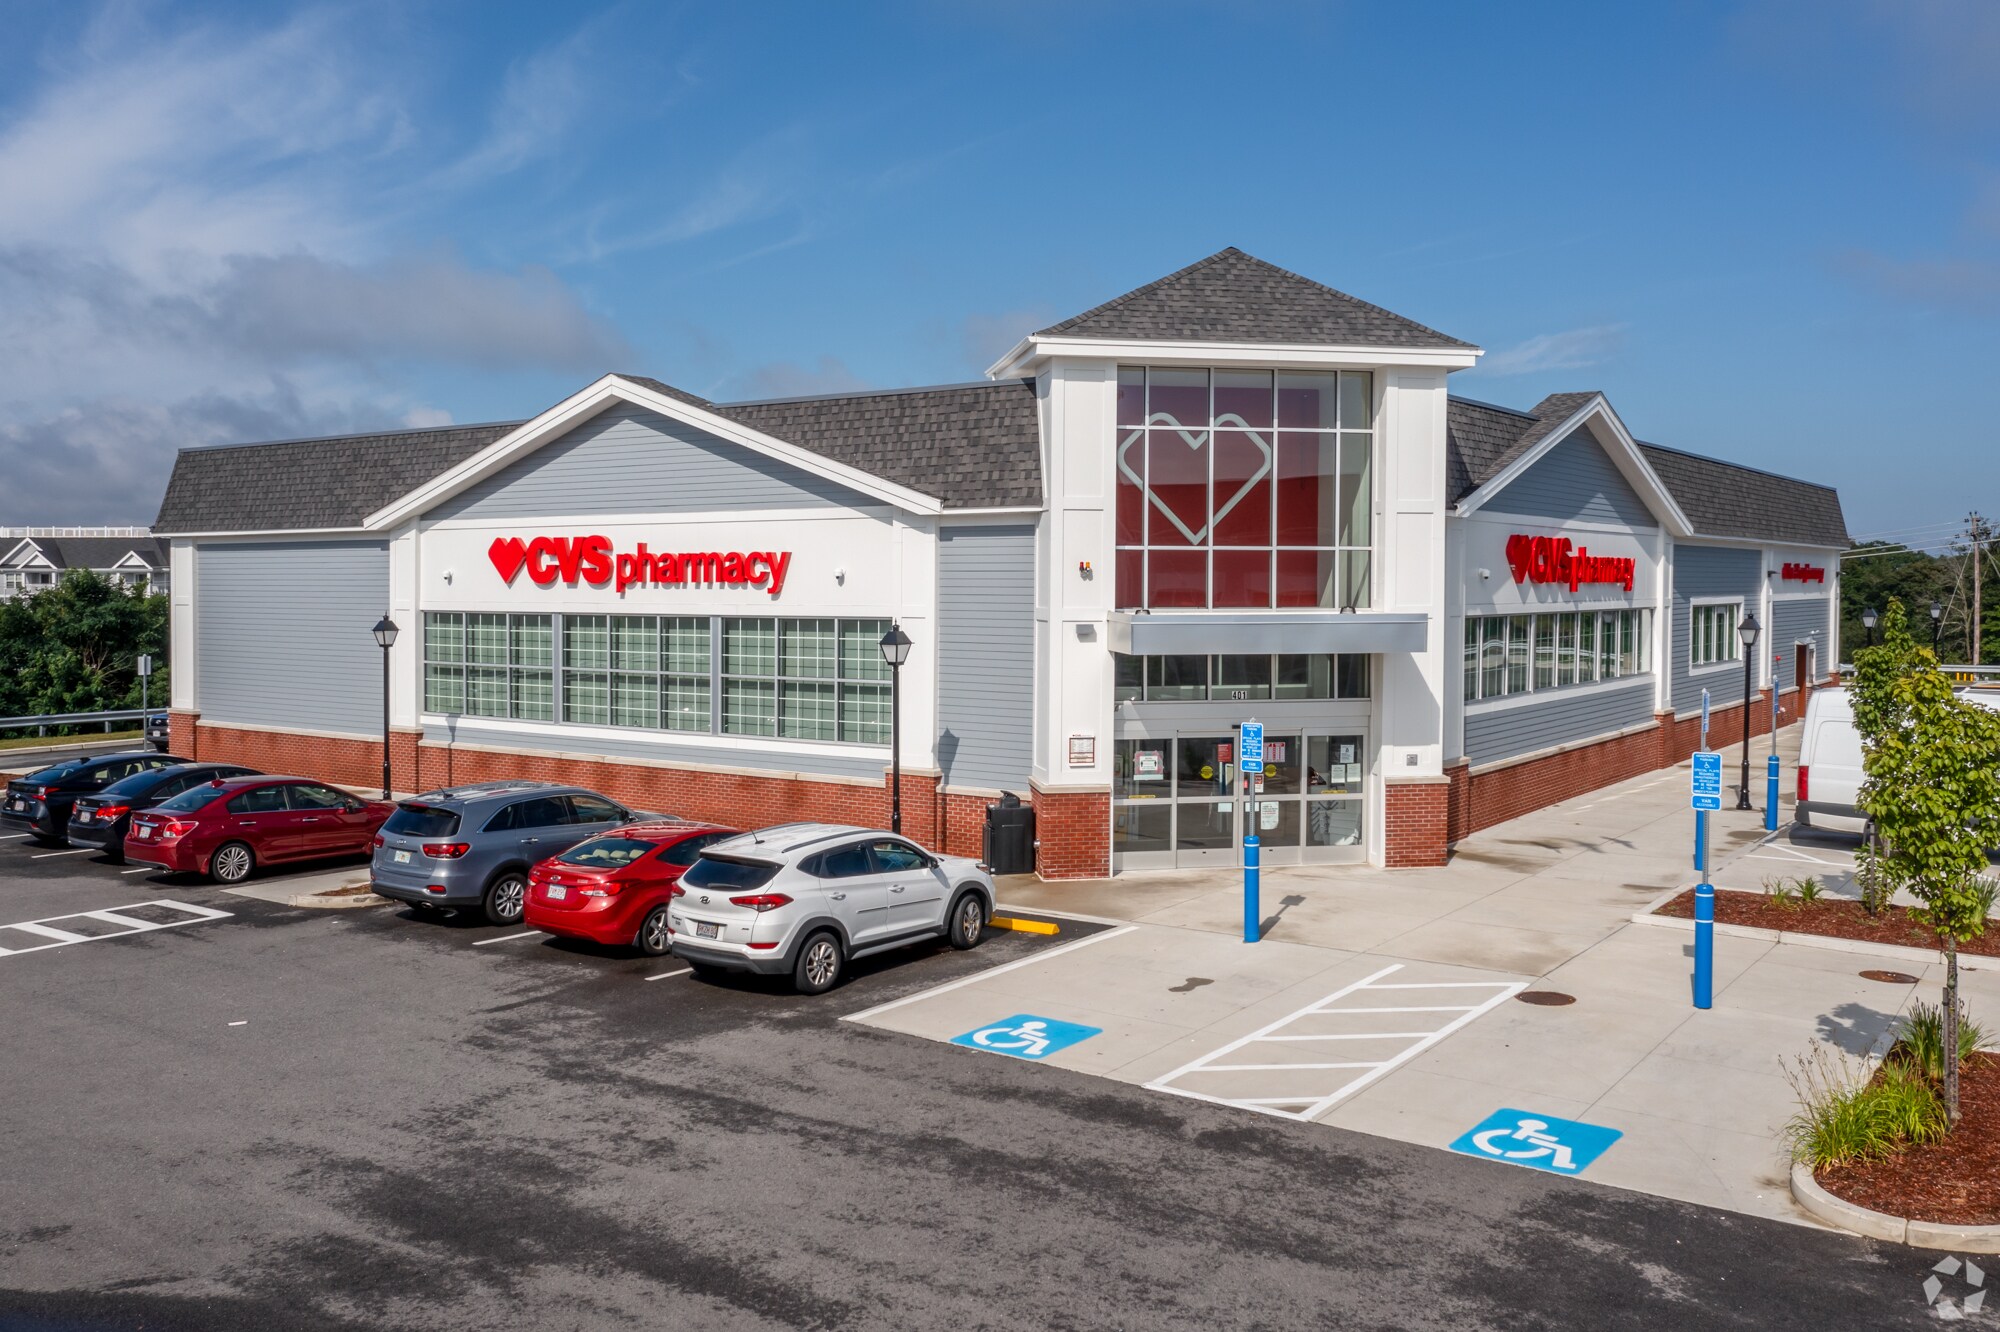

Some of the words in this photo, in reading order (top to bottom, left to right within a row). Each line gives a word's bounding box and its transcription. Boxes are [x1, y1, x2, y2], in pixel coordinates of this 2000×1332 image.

[526, 535, 613, 590] CVS
[616, 543, 792, 594] pharmacy
[1528, 536, 1572, 584] CVS
[1569, 547, 1635, 592] pharmacy
[1232, 690, 1247, 699] 401
